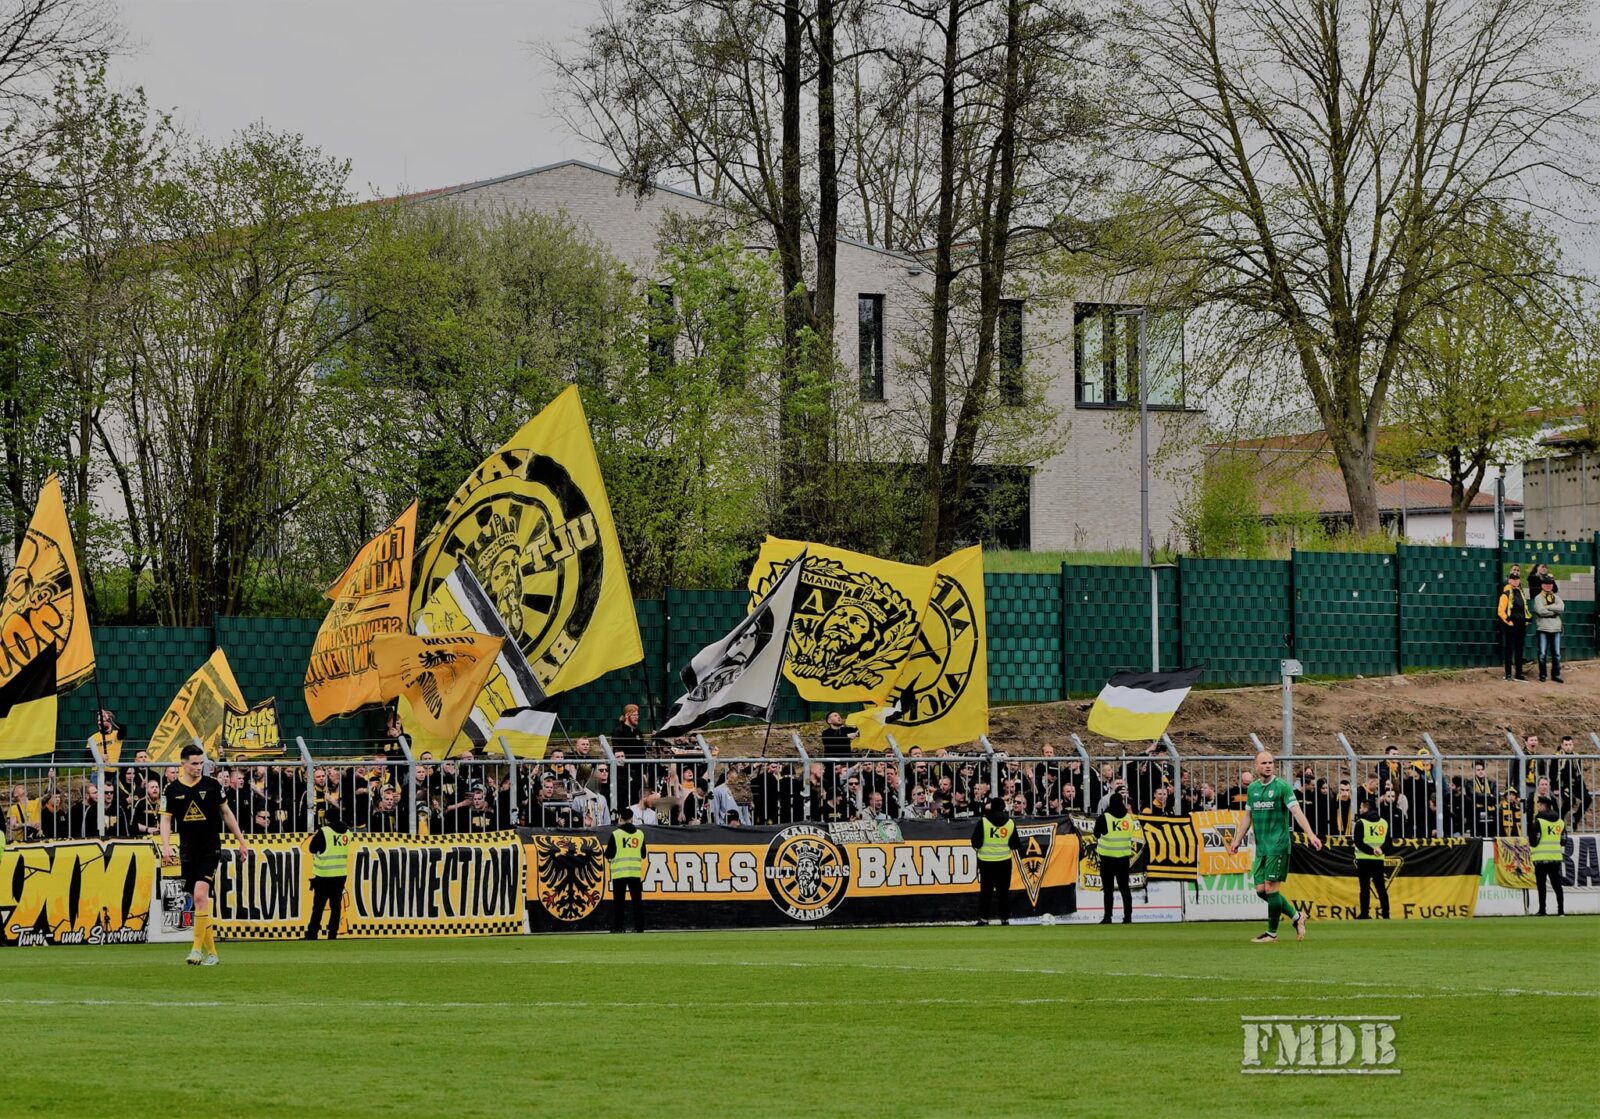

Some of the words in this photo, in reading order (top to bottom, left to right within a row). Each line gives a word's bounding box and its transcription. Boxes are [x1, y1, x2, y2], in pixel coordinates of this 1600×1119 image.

[779, 825, 827, 839] KARLS
[1112, 820, 1130, 831] K9
[1369, 825, 1385, 837] K9
[1547, 825, 1562, 836] K9
[989, 827, 1008, 839] K9
[333, 834, 349, 847] K9
[622, 837, 639, 848] K9
[609, 852, 758, 892] ARLS
[856, 846, 981, 888] BAND
[211, 847, 300, 920] ELLOW
[355, 843, 519, 918] CONNECTION
[786, 903, 833, 920] BANDE
[61, 927, 84, 944] und
